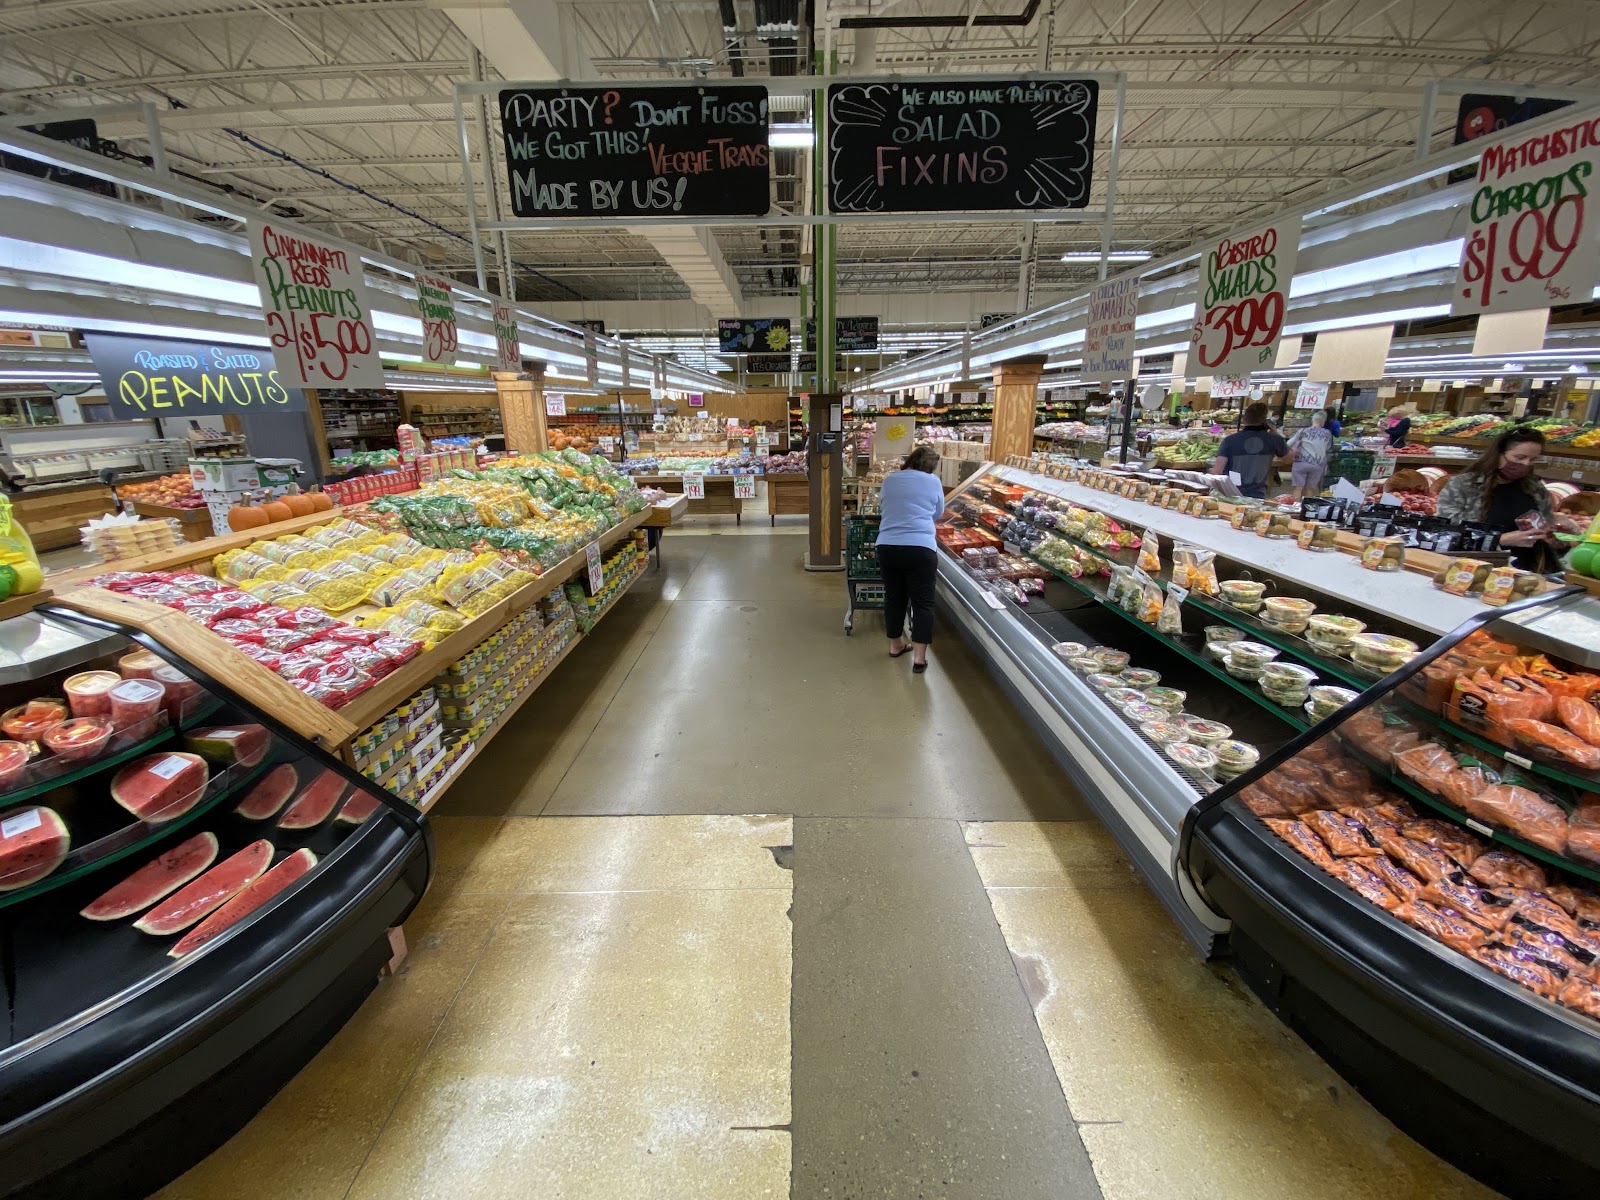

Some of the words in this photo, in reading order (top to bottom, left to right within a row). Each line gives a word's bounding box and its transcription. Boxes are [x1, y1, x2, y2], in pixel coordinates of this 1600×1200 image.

[701, 95, 768, 126] FUSS!
[902, 88, 923, 106] WE
[931, 89, 965, 105] ALSO
[969, 88, 1003, 104] HAVE
[1006, 86, 1062, 103] PLENTY
[892, 105, 1000, 143] SALAD
[507, 132, 539, 160] WE
[545, 132, 590, 160] GOT
[589, 128, 651, 156] THIS!
[648, 142, 713, 176] VEGGIE
[708, 138, 769, 170] TRAYS
[876, 146, 1008, 187] FIXINS
[513, 168, 578, 211] MADE
[590, 179, 623, 210] BY
[632, 176, 687, 211] US!
[1470, 161, 1593, 224] CARROTS
[1217, 228, 1277, 270] BISTRO
[261, 256, 362, 320] PEANUTS
[287, 256, 331, 288] REDS
[1204, 251, 1277, 310] SALADS
[134, 350, 198, 371] ROASTED
[211, 347, 260, 370] SALTED
[1258, 347, 1272, 363] EA
[119, 371, 288, 412] PEANUTS
